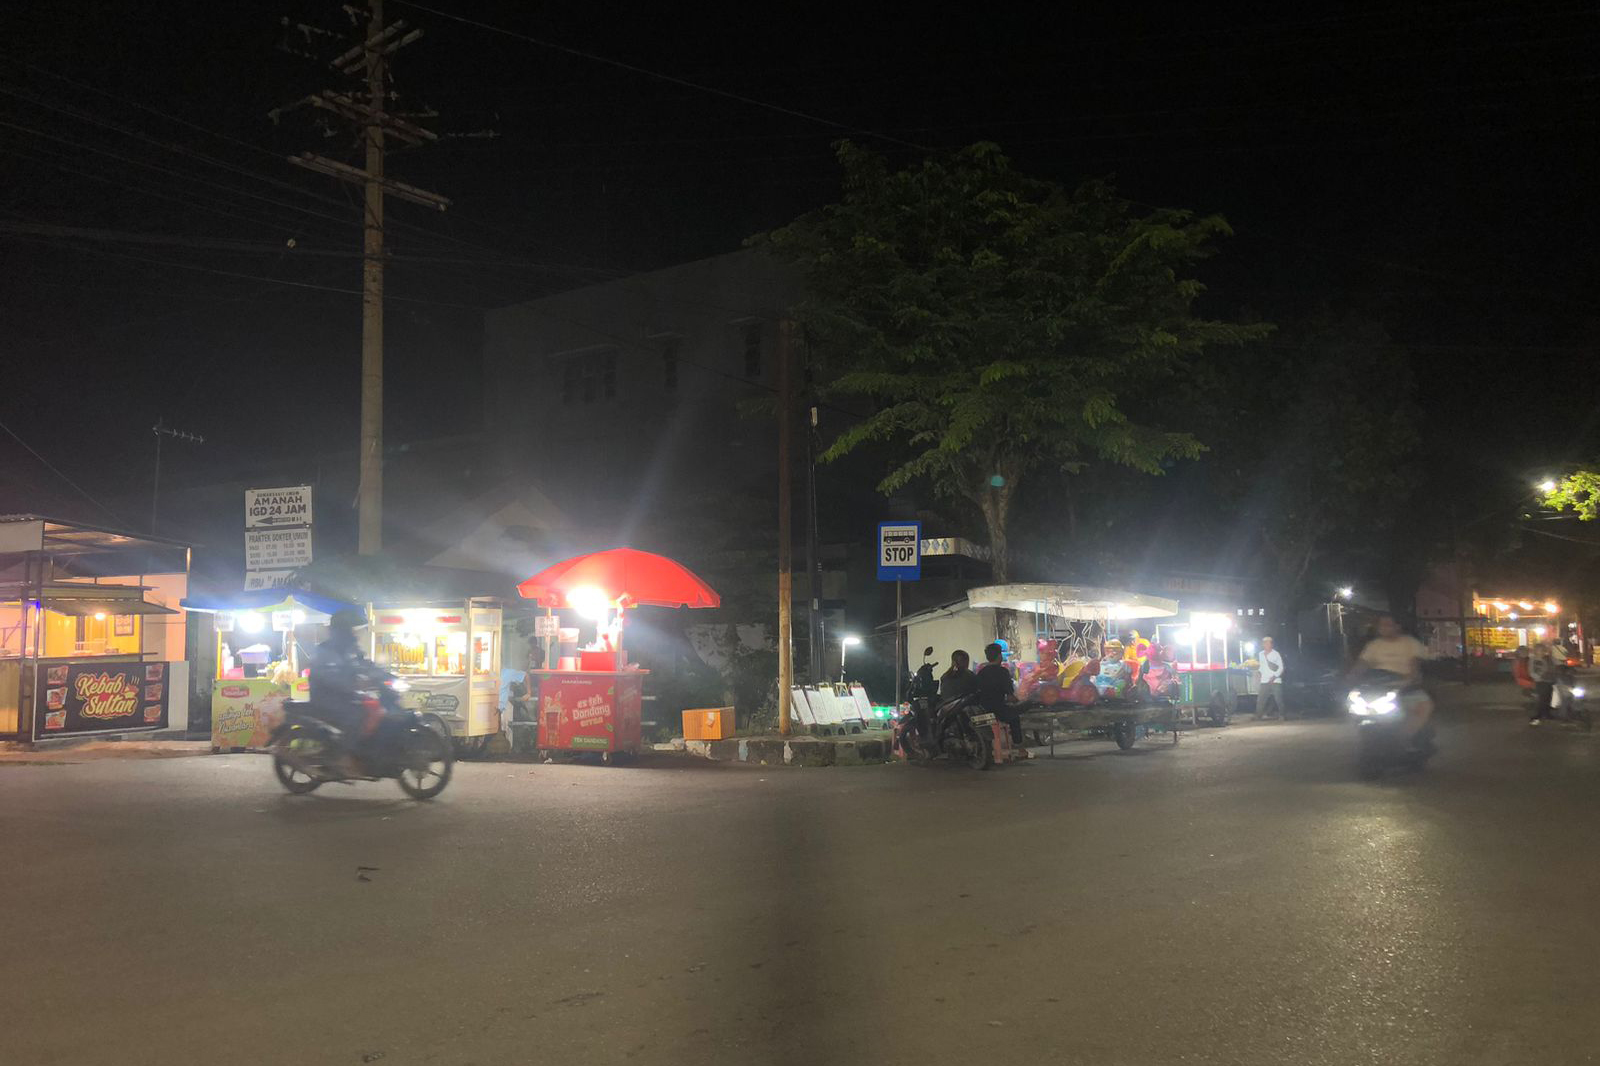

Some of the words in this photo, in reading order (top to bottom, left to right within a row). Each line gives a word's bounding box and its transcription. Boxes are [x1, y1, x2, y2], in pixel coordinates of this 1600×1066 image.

[254, 496, 303, 506] AMANAH
[249, 507, 267, 516] IGD
[269, 506, 281, 515] 24
[285, 505, 306, 515] JAM
[885, 547, 914, 562] STOP
[78, 675, 123, 695] Kebab
[85, 695, 137, 715] Sultan
